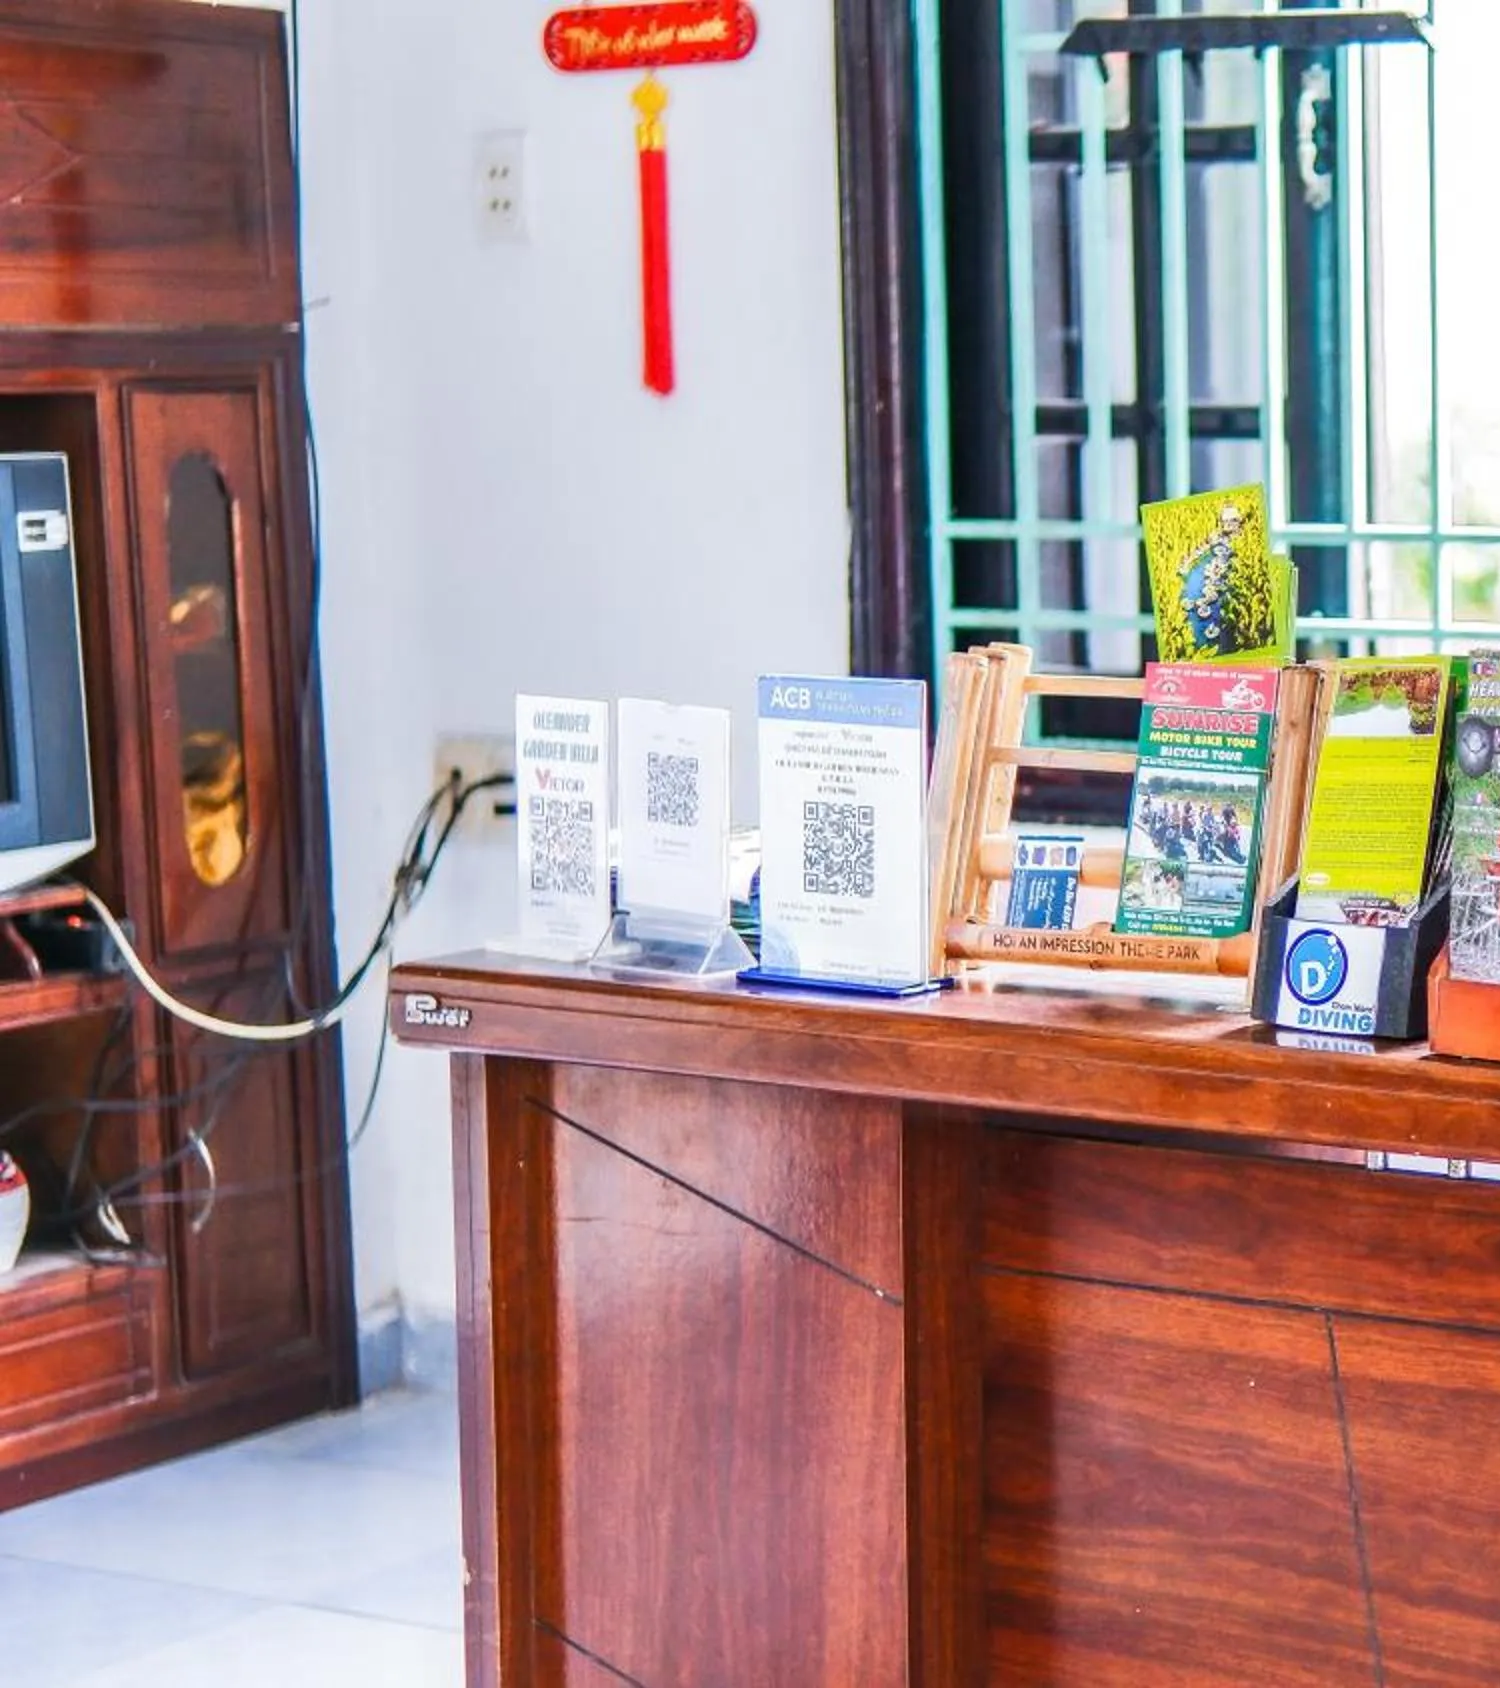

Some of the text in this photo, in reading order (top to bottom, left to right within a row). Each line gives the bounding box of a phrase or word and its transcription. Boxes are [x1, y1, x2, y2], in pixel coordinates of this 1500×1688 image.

[770, 686, 811, 709] ACB
[1149, 731, 1190, 745] MOTOR
[1160, 745, 1243, 763] BICYCLE TOUR
[1040, 937, 1114, 955] IMPRESSION
[1168, 945, 1200, 960] PARK
[1298, 1007, 1373, 1033] DIVING
